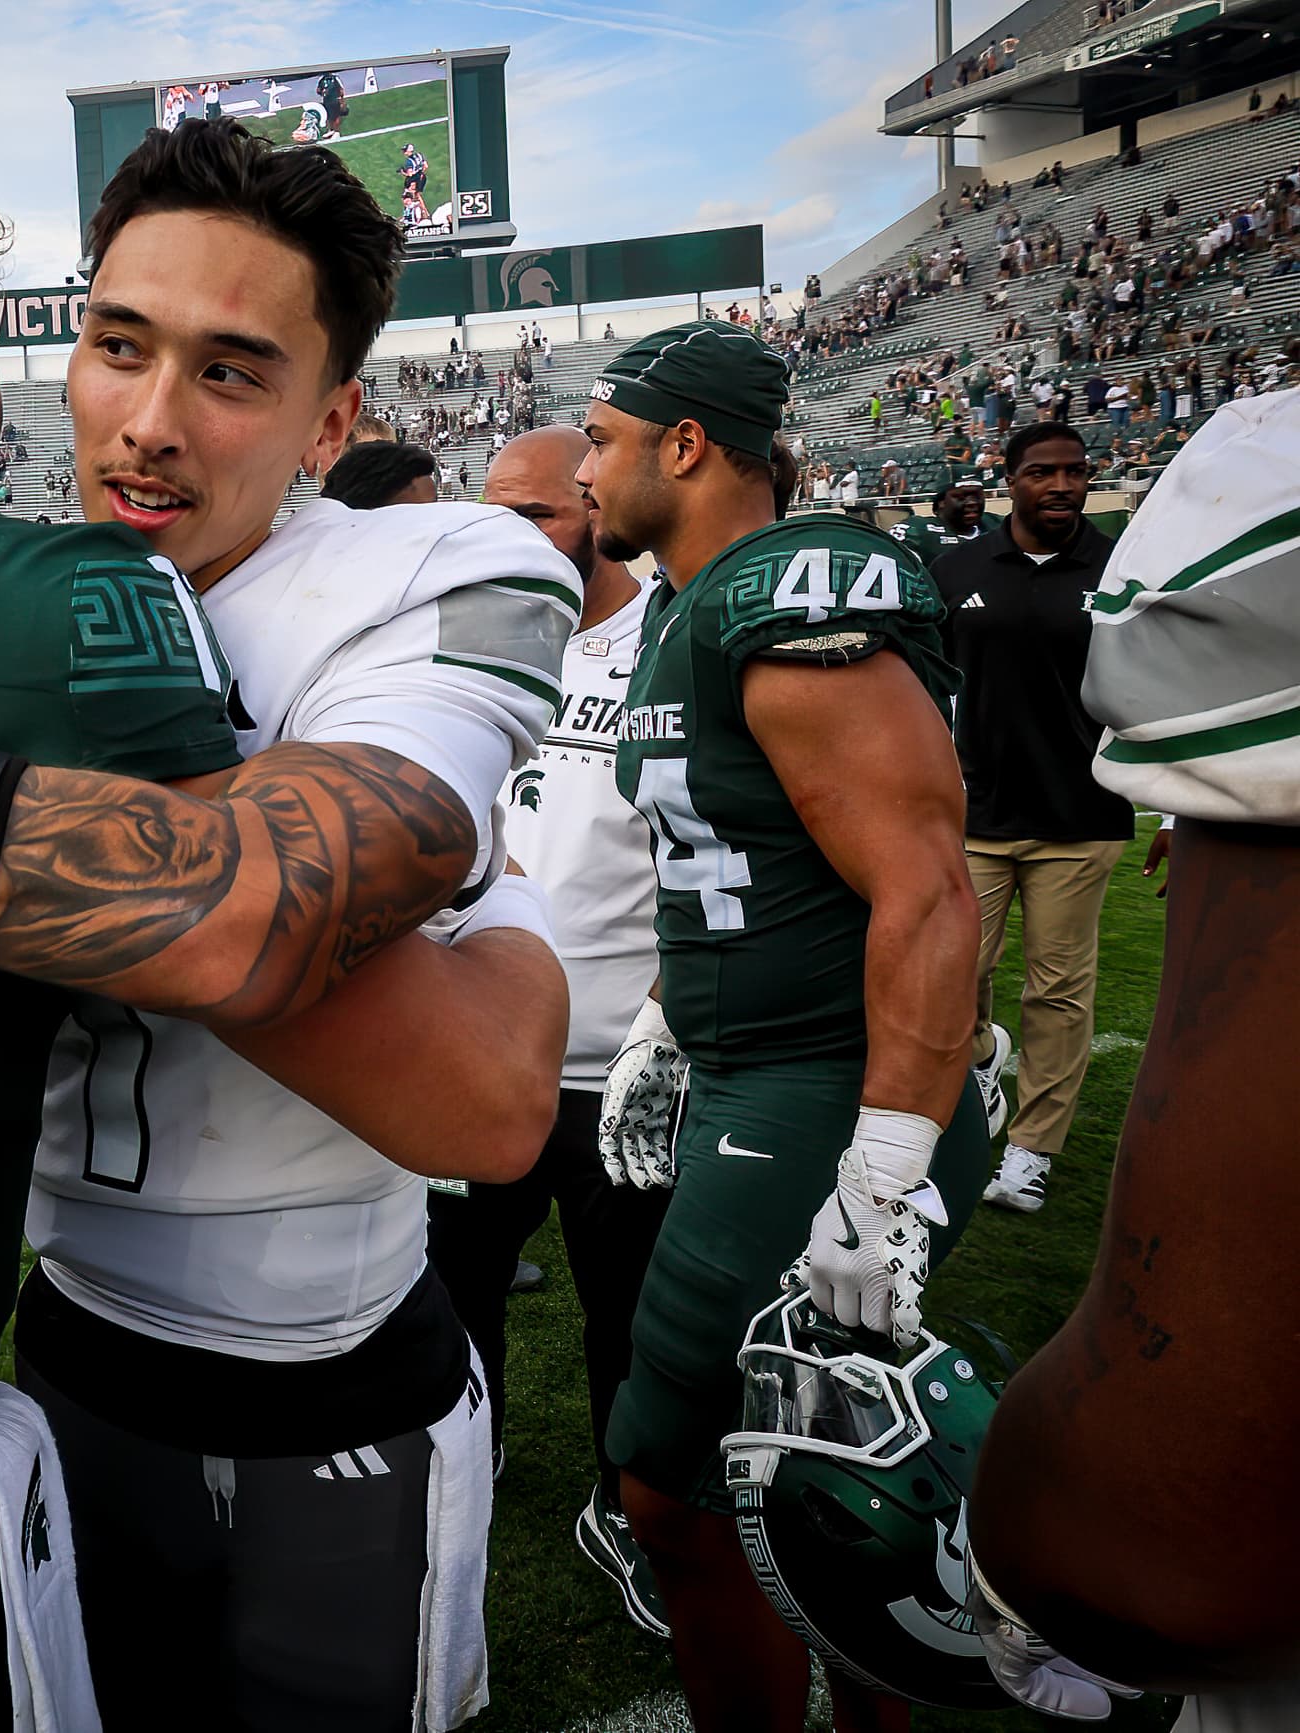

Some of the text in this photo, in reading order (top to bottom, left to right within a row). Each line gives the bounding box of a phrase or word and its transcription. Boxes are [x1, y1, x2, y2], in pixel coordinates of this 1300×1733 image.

[462, 193, 489, 214] 25
[773, 548, 903, 624] 44
[630, 702, 686, 740] STATE
